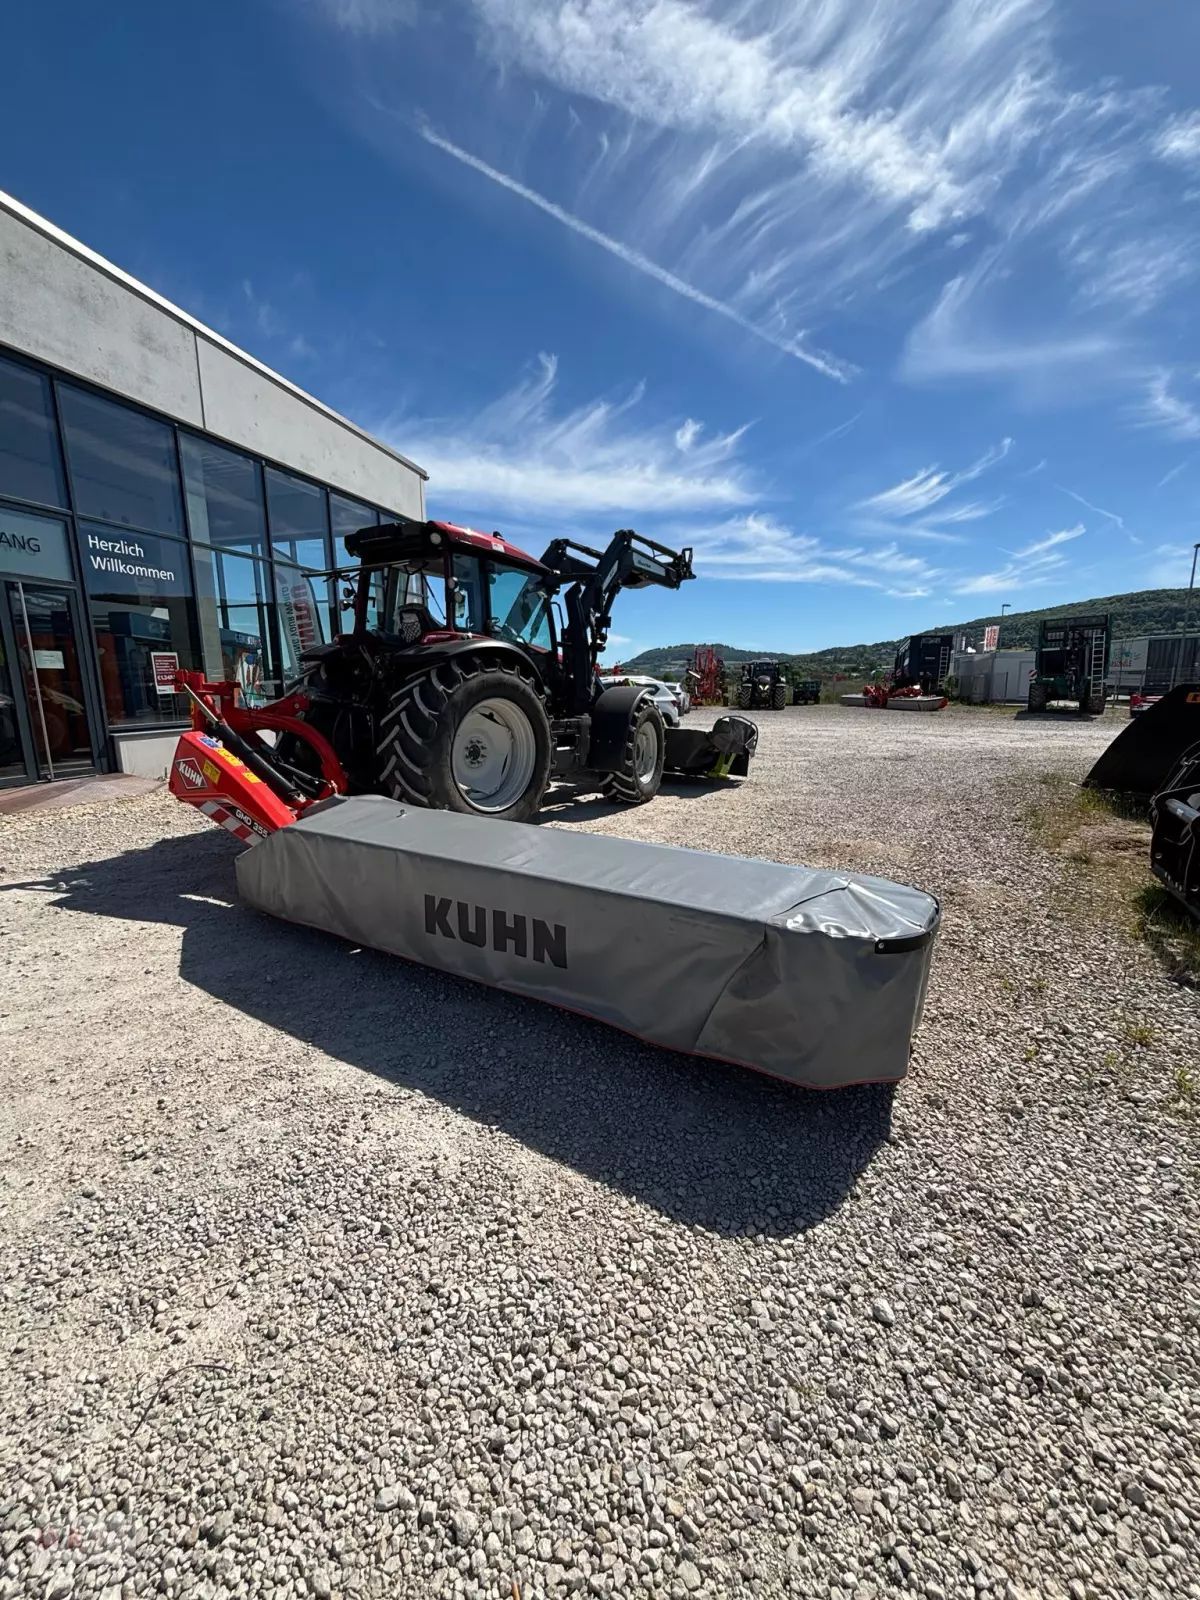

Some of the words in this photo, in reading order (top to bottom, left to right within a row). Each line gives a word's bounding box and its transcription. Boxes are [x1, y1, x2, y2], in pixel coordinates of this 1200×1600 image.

[0, 532, 41, 552] ANG
[88, 534, 144, 557] Herzlich
[90, 555, 175, 581] Willkommen
[179, 761, 204, 787] KUHN
[235, 809, 252, 825] GMD
[252, 821, 269, 838] 355
[424, 894, 568, 969] KUHN
